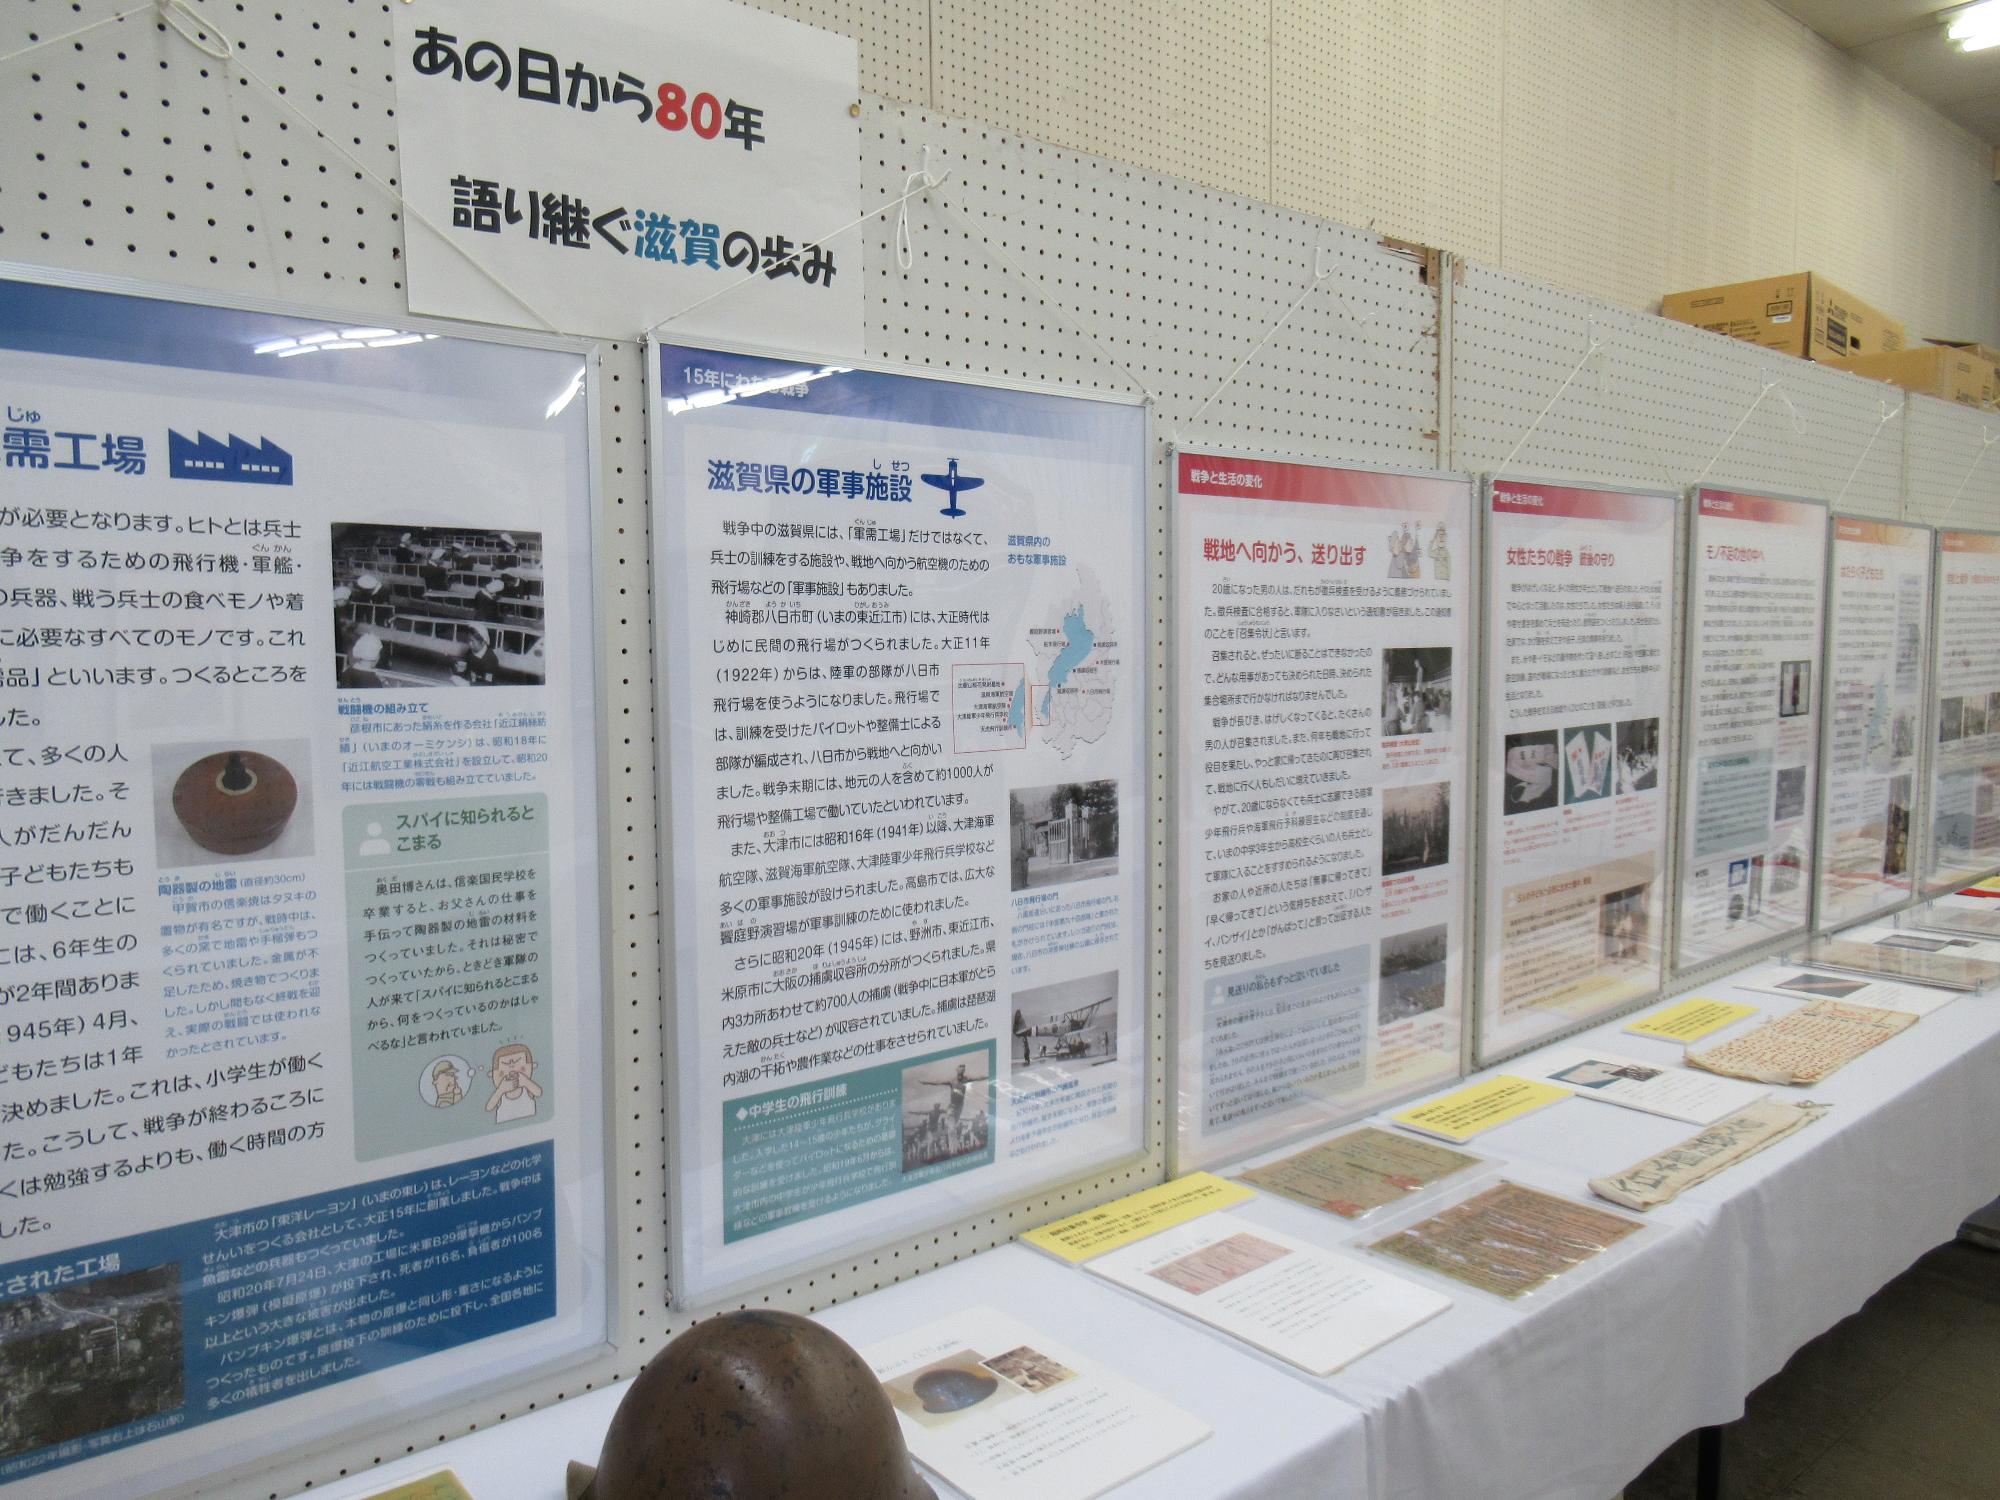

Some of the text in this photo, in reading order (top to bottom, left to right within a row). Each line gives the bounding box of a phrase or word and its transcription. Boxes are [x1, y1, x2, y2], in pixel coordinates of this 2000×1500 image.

[412, 26, 766, 151] あの日から80年
[450, 174, 837, 287] 語り継ぐ滋賀の歩み
[708, 459, 913, 503] 滋賀県の軍事施設
[1190, 468, 1262, 488] 戦争と生活の変化
[723, 520, 989, 546] 戦争中の滋賀県には、「軍需工場」だけではなくて、
[1007, 534, 1051, 547] 滋賀県内の
[710, 550, 989, 572] 兵士の訓練をする施設や、戦地へ向かう航空機のための
[1007, 553, 1067, 566] おもな軍事施設
[1203, 538, 1366, 566] 戦地へ向かう、送り出す
[711, 580, 913, 598] 飛行場などの「軍事施設」もありました。
[713, 636, 990, 653] じめに民間の飛行場がつくられました。大正11年
[0, 665, 307, 688] 品」といいます。つくるところを
[338, 703, 429, 716] 戦闘機の組み立て
[713, 690, 940, 713] 飛行場を使うようになりました。飛行場で
[715, 716, 941, 742] は、訓練を受けたパイロットや整備士による
[0, 744, 128, 767] て、多くの人
[715, 743, 942, 771] 部隊が編成され、八日市から戦地へと向かい
[717, 764, 994, 799] ました。戦争末期には、地元の人を含めて約1000人が
[0, 782, 129, 807] きました。そ
[397, 805, 534, 830] スパイに知られると
[717, 793, 969, 830] 飛行場や整備工場で働いていたといわれています。
[397, 834, 442, 851] こまる
[719, 842, 995, 888] 航空隊、滋賀海軍航空隊、大津陸軍少年飛行兵学校など
[720, 865, 995, 917] 多くの軍事施設が設けられました。高島市では、広大な
[1, 896, 136, 925] で働くことに
[363, 889, 537, 920] 卒業すると、お父さんの仕事を
